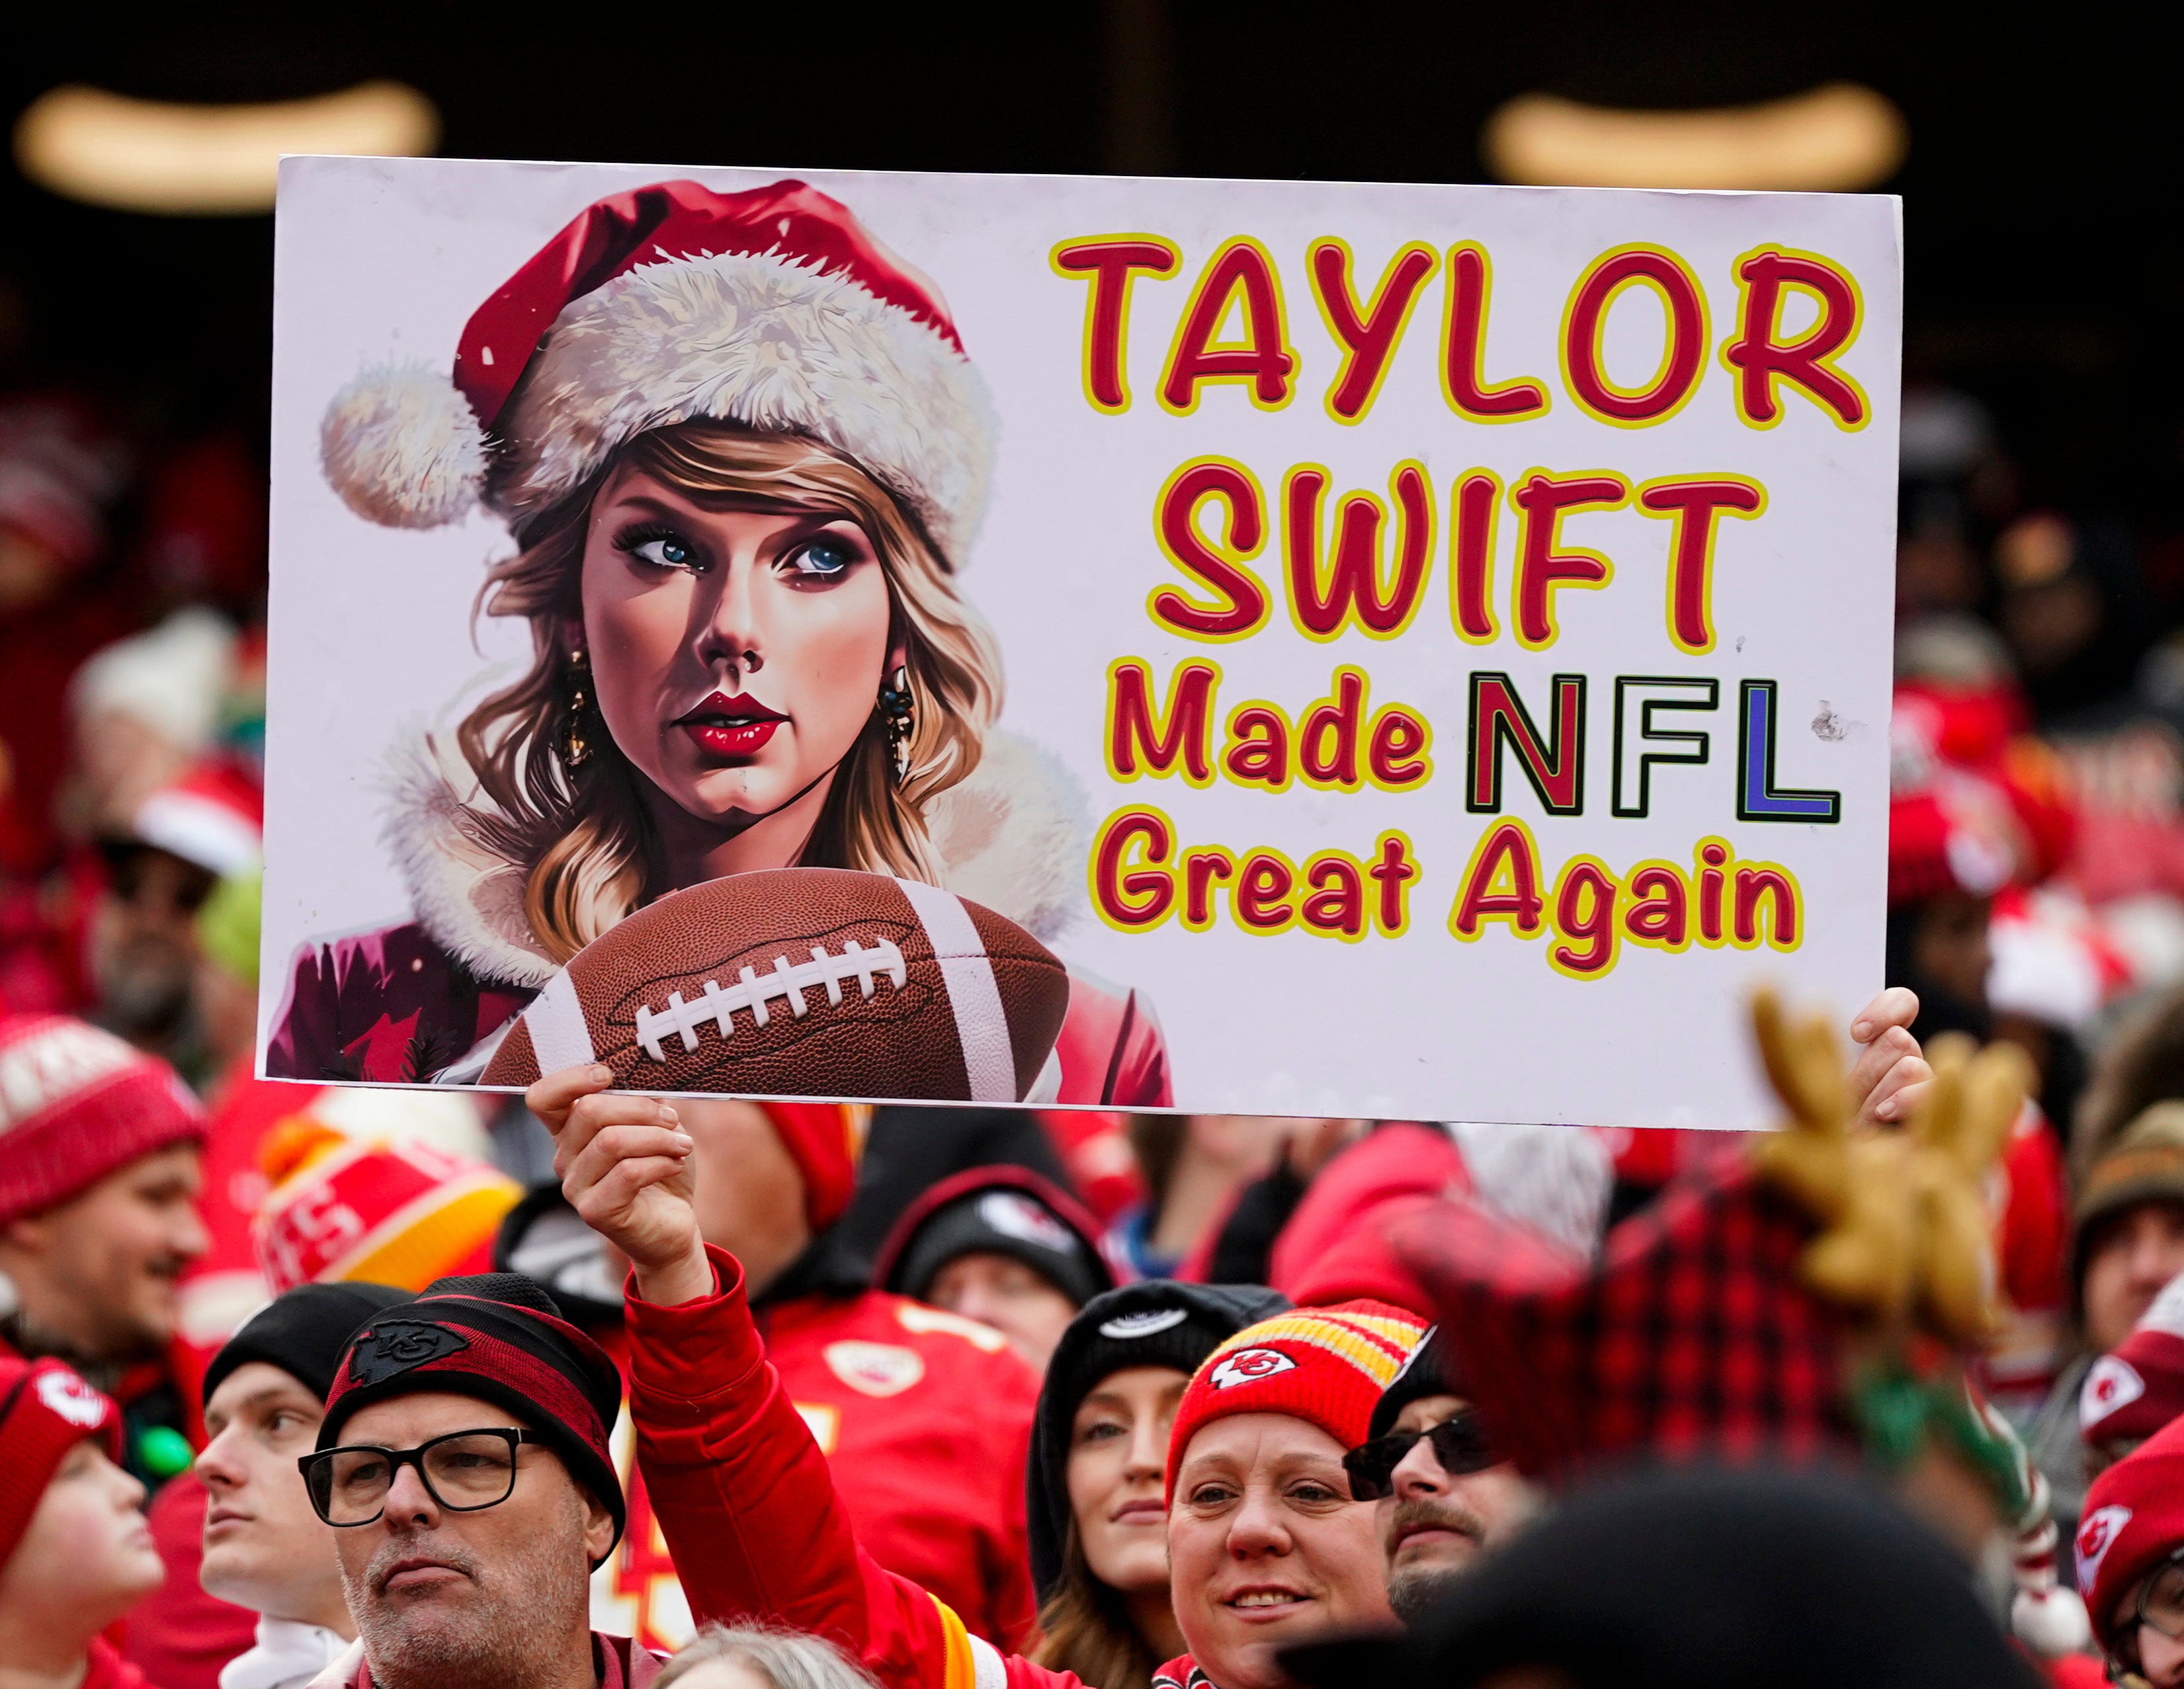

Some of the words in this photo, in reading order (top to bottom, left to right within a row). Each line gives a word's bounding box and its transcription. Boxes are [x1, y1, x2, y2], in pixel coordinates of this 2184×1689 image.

[1048, 233, 1871, 433] TAYLOR
[1146, 455, 1769, 656] SWIFT
[1104, 656, 1433, 794] Made
[1466, 671, 1840, 823] NFL
[1087, 804, 1422, 944] Great
[1447, 816, 1804, 981] Again
[1228, 1351, 1281, 1376] KC
